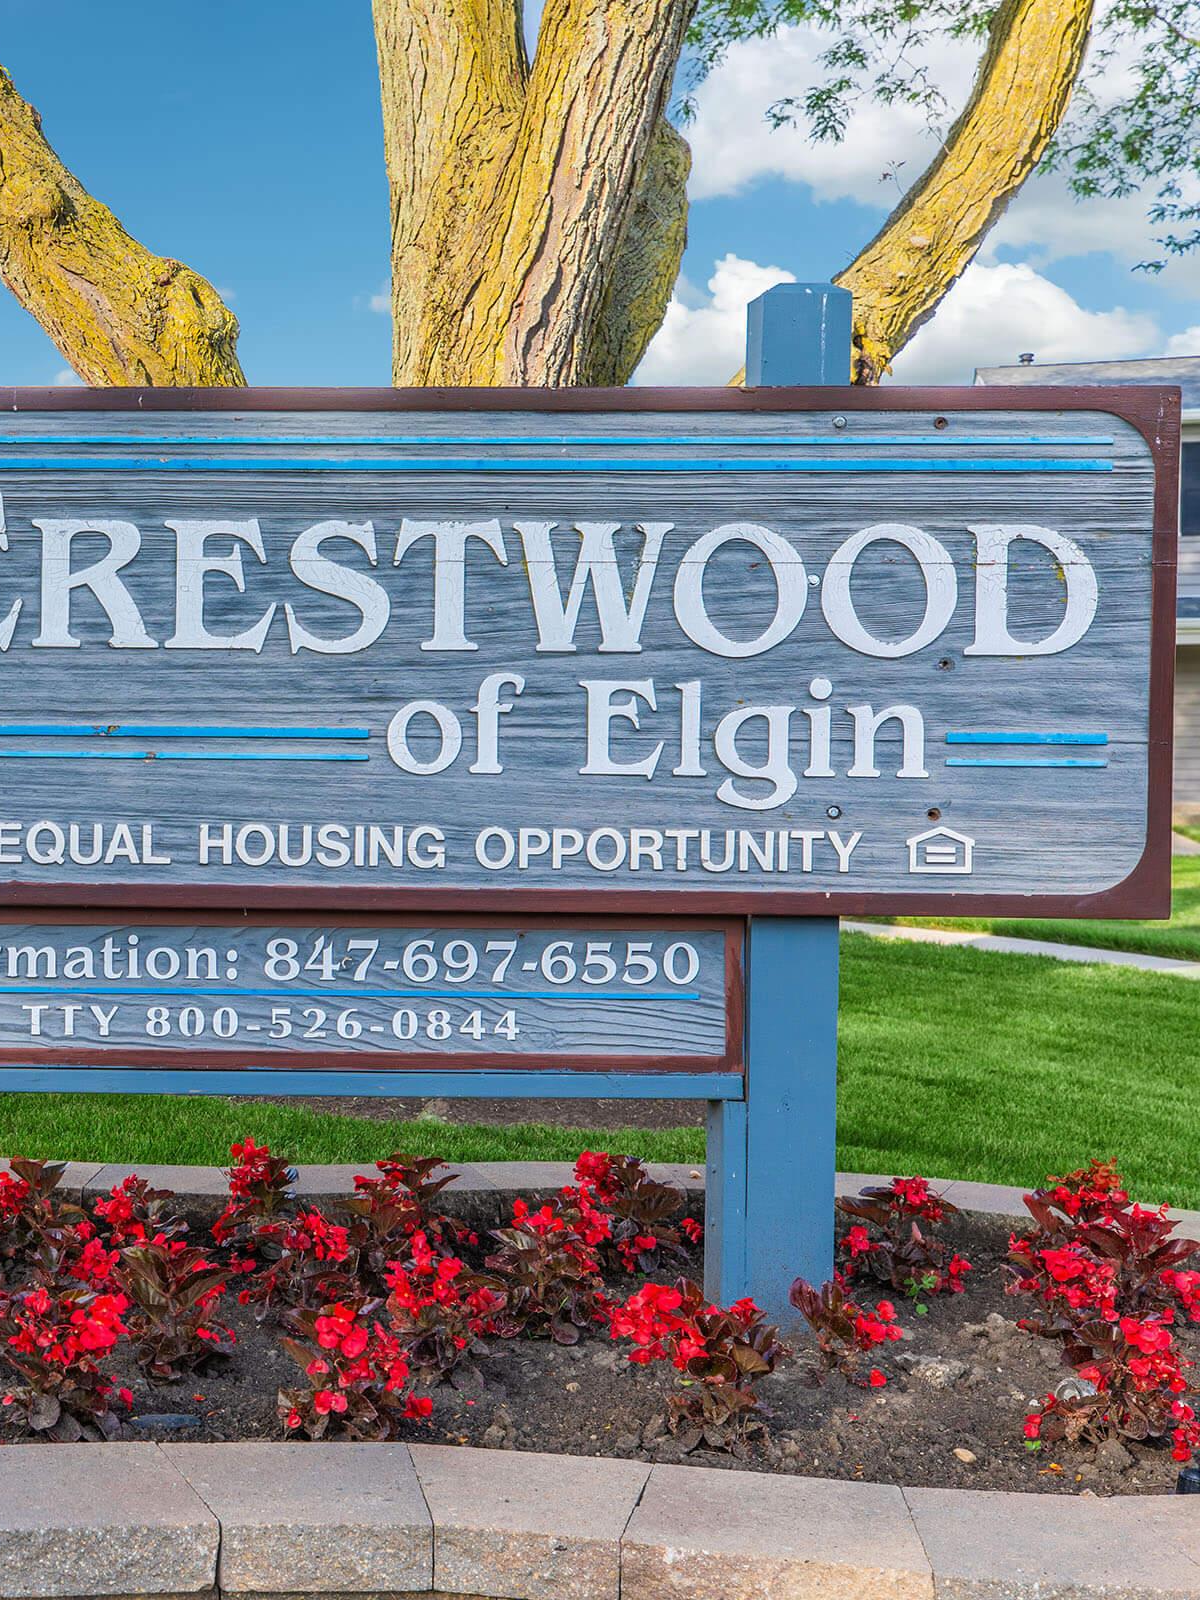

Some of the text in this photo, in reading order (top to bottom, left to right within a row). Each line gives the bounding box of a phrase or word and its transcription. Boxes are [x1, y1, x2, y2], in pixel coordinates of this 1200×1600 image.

[387, 672, 930, 811] of Elgin
[199, 823, 446, 869] HOUSING
[474, 825, 864, 873] OPPORTUNITY
[263, 934, 701, 985] 847-697-6550
[21, 1004, 521, 1041] TTY 800-526-0844
